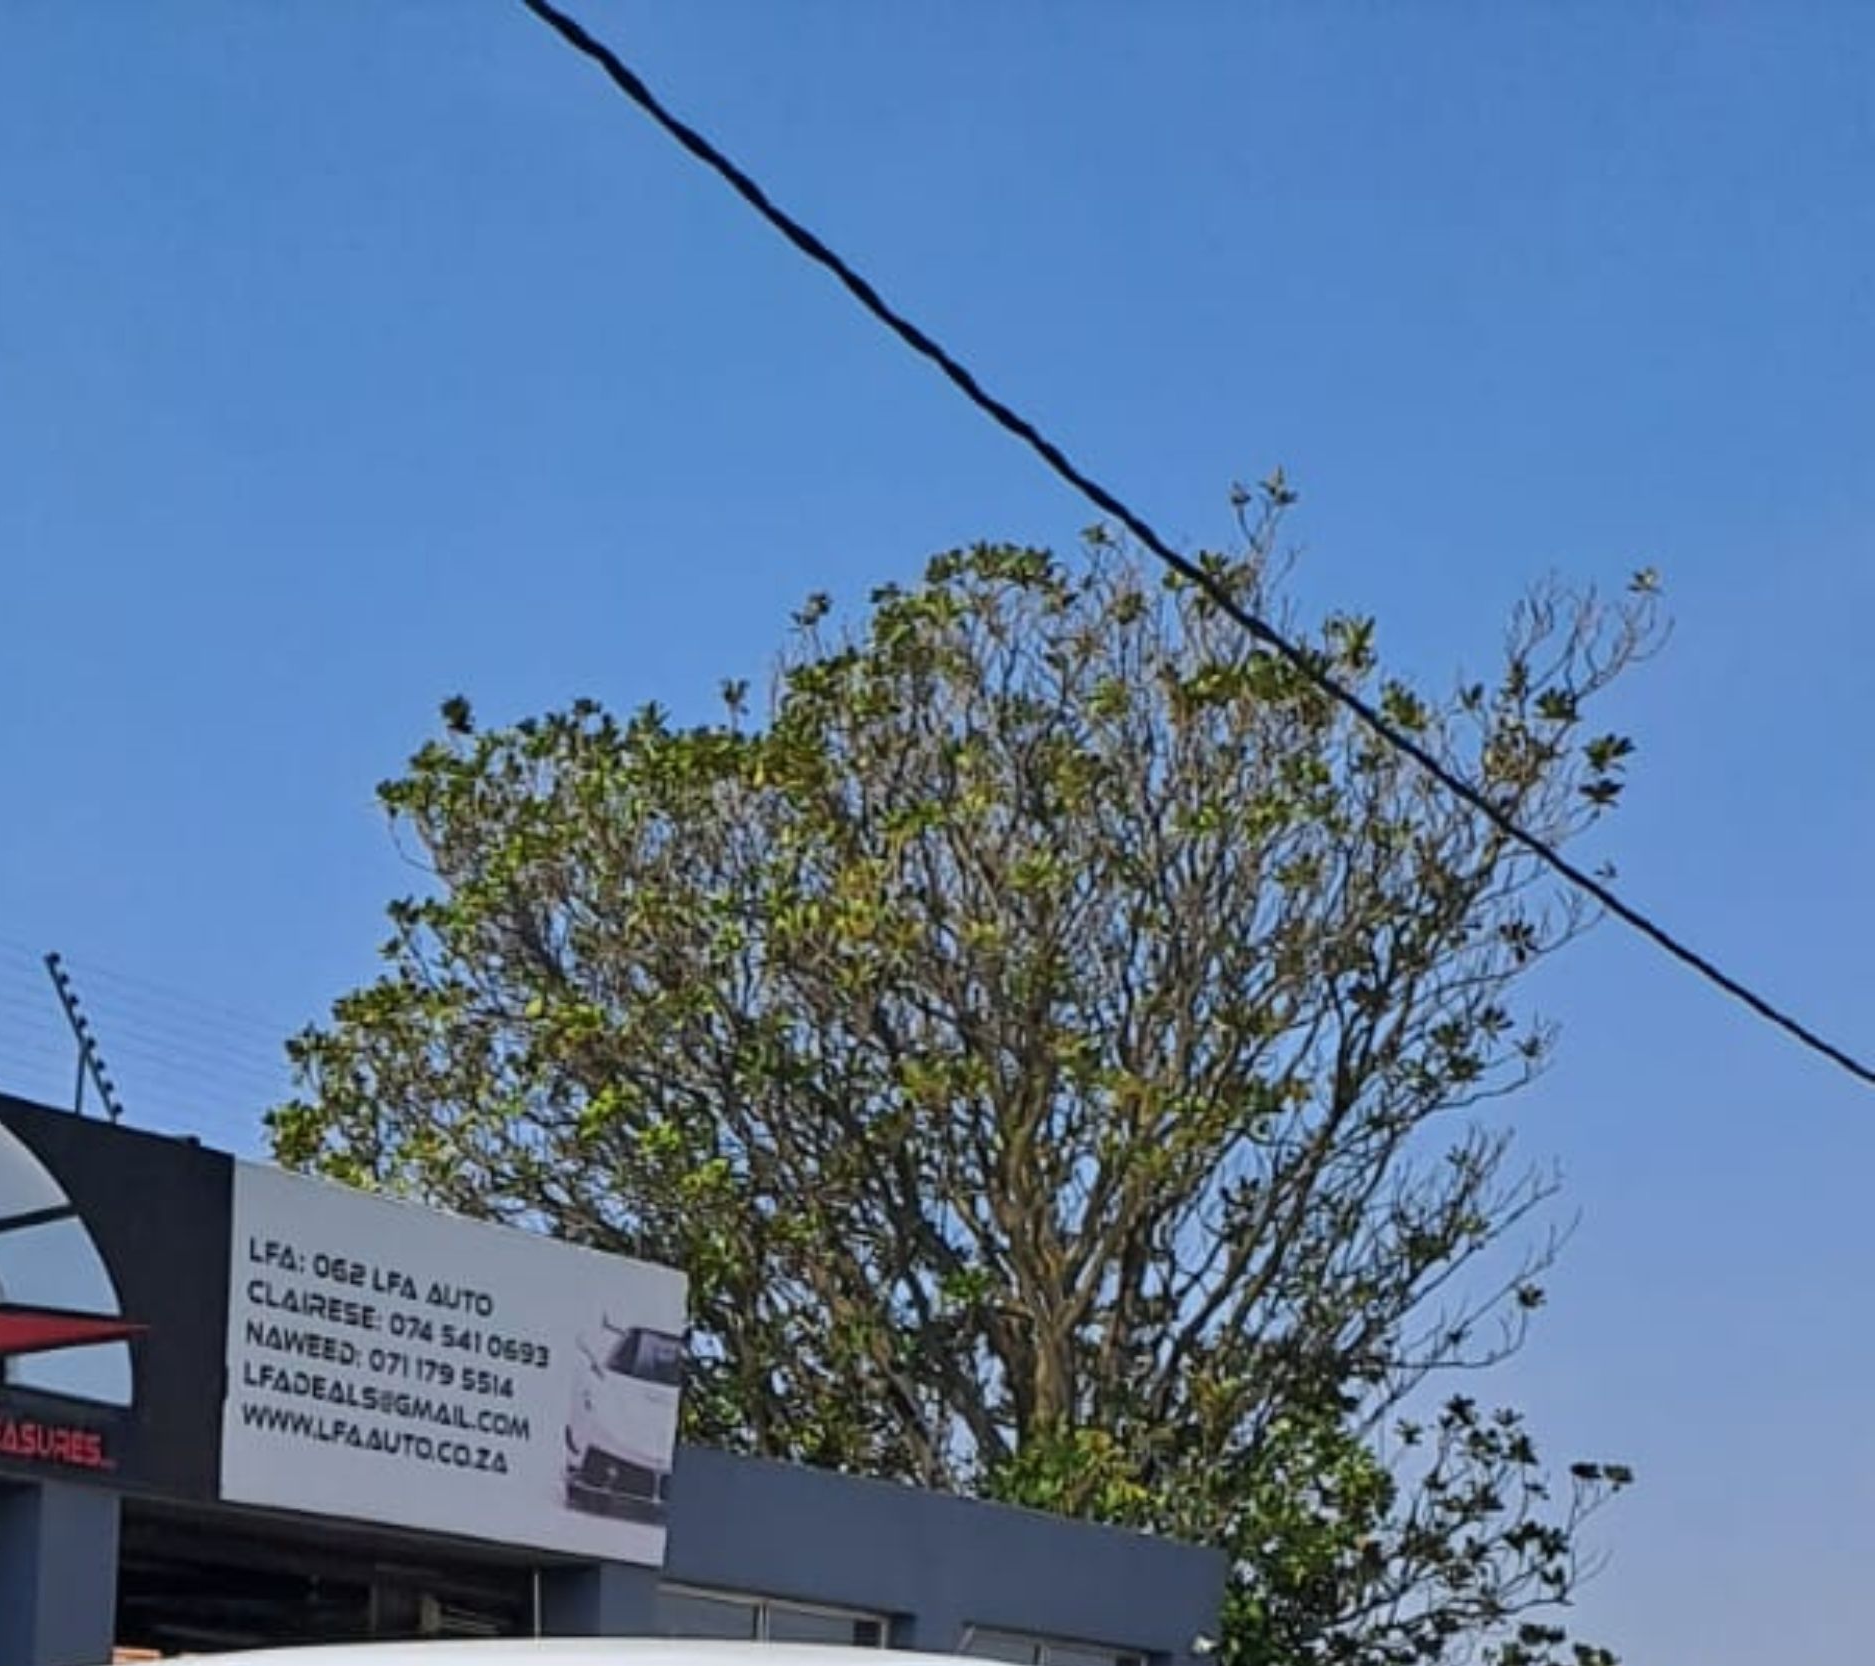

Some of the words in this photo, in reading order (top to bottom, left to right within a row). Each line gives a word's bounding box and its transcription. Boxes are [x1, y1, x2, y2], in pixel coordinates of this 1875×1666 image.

[249, 1236, 306, 1274] LFA:
[313, 1252, 367, 1288] 062
[372, 1267, 418, 1301] LFA
[426, 1282, 494, 1318] AUTO
[246, 1318, 362, 1369] NAWEED:
[369, 1348, 409, 1379] 071
[416, 1356, 455, 1386] 179
[461, 1366, 514, 1398] 5514
[247, 1279, 383, 1332] CLAIRESE:
[390, 1311, 433, 1342] 074
[441, 1324, 482, 1353] 541
[487, 1334, 550, 1369] 0693
[241, 1401, 508, 1475] WWW.LFAAUTO.CO.ZA
